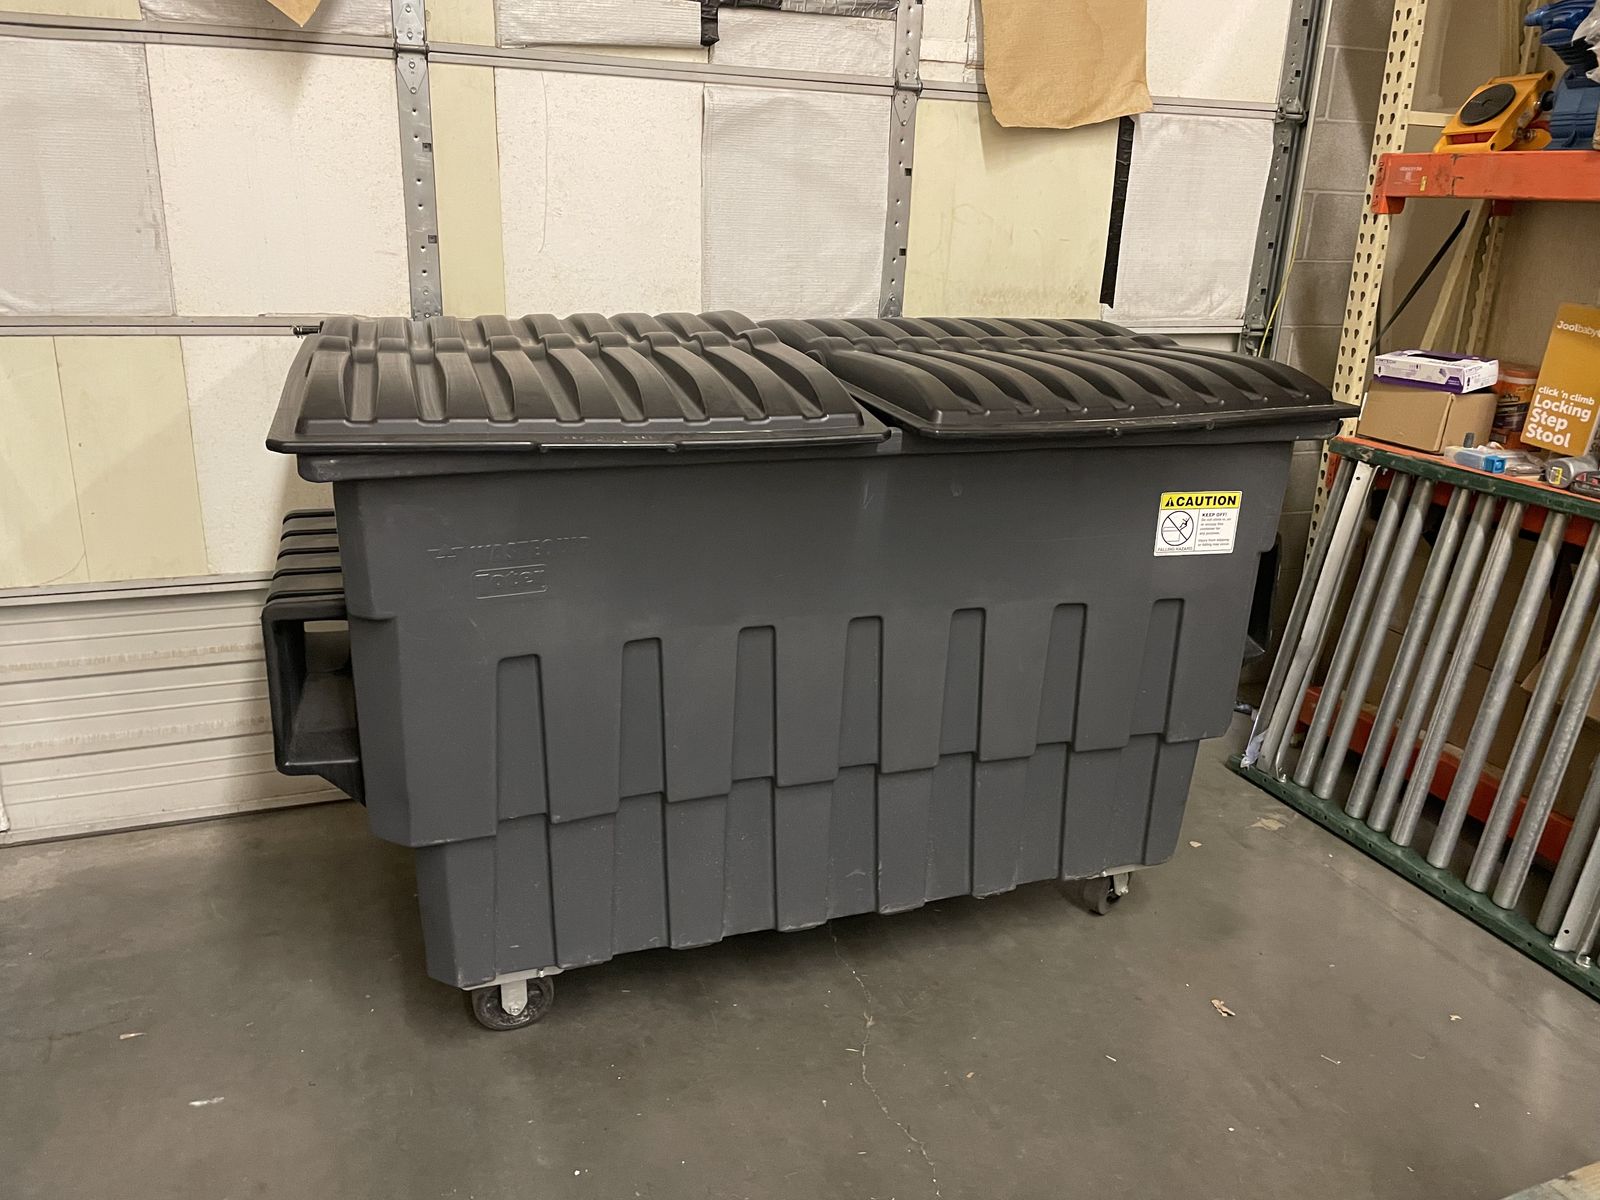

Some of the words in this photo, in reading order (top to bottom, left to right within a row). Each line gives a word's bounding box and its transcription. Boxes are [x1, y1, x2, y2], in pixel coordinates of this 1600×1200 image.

[1538, 386, 1559, 397] click
[1570, 393, 1595, 405] climb
[1530, 408, 1568, 432] Step
[1534, 394, 1592, 422] Locking
[1526, 423, 1571, 448] Stool
[1176, 495, 1237, 507] CAUTION
